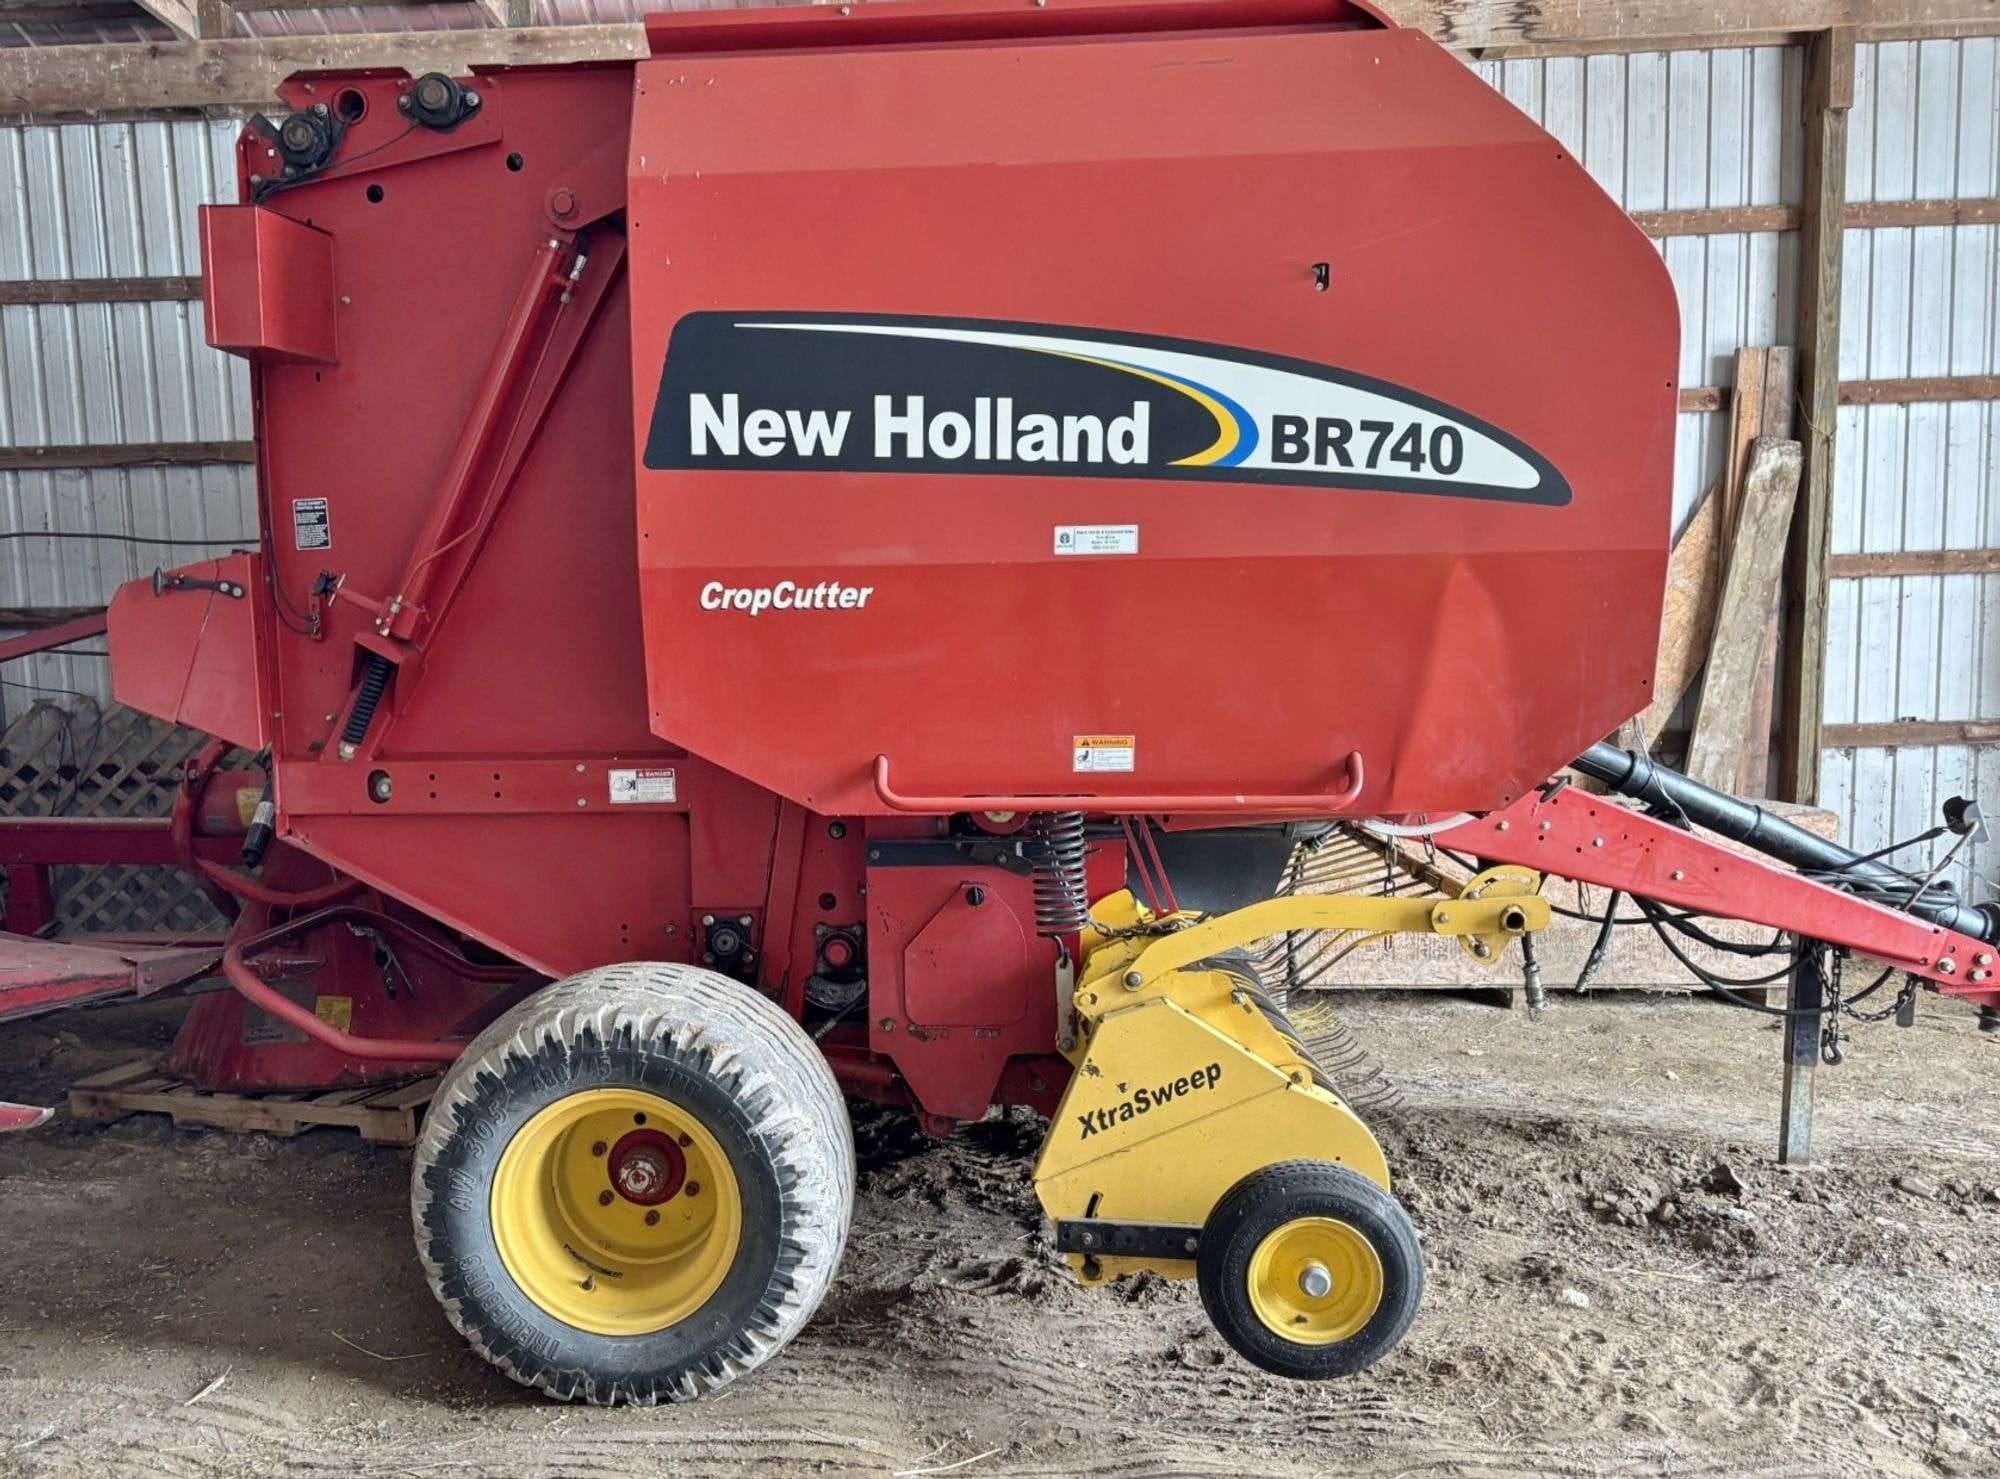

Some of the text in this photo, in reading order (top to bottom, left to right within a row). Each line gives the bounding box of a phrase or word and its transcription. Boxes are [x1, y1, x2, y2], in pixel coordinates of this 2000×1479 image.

[689, 392, 1150, 465] New Holland
[1271, 414, 1464, 476] BR740
[700, 581, 874, 616] CropCutter
[1091, 738, 1128, 746] WARNING
[1077, 1062, 1222, 1140] XtraSweep
[459, 1254, 560, 1362] TRELLEBORG
